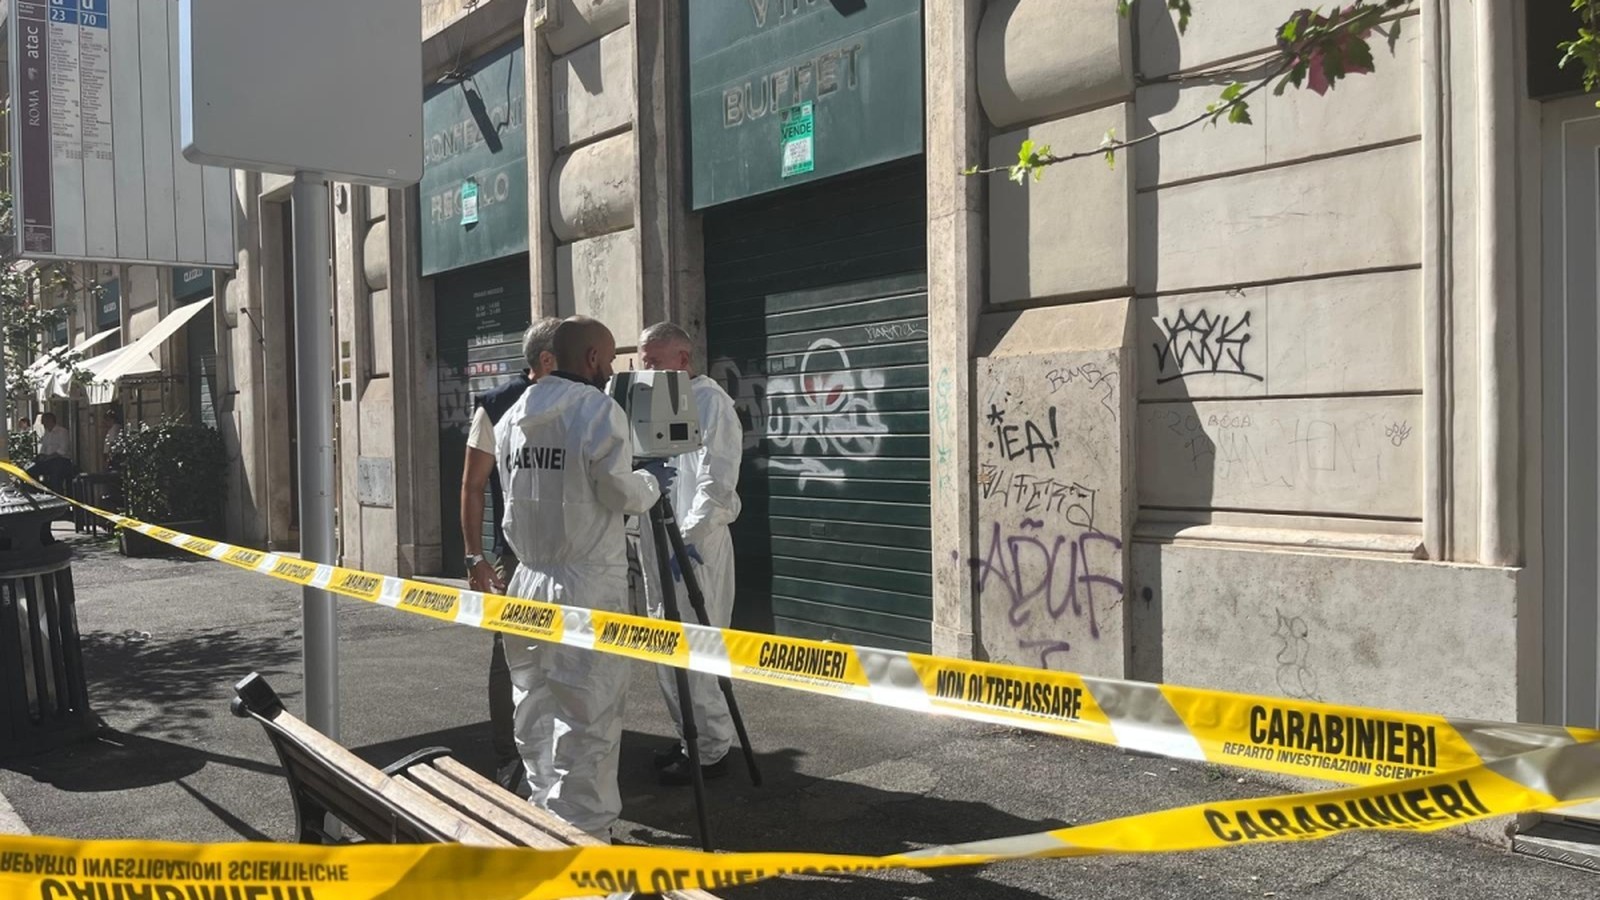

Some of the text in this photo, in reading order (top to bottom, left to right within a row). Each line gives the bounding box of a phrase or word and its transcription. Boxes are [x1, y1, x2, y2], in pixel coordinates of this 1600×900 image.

[51, 8, 66, 21] 23
[82, 13, 97, 26] 70
[26, 26, 39, 59] atac
[723, 43, 862, 129] BUFFET
[28, 89, 41, 127] ROMA
[782, 121, 812, 139] VENDE
[500, 602, 557, 629] CARABINIERI
[758, 640, 848, 679] CARABINIERI
[936, 669, 1083, 723] NON OLTREPASSARE
[1250, 704, 1437, 768] CARABINIERI
[1222, 741, 1274, 762] REPARTO
[1276, 749, 1372, 775] INVESTIGAZIONI
[1203, 779, 1492, 842] CARABINIERI
